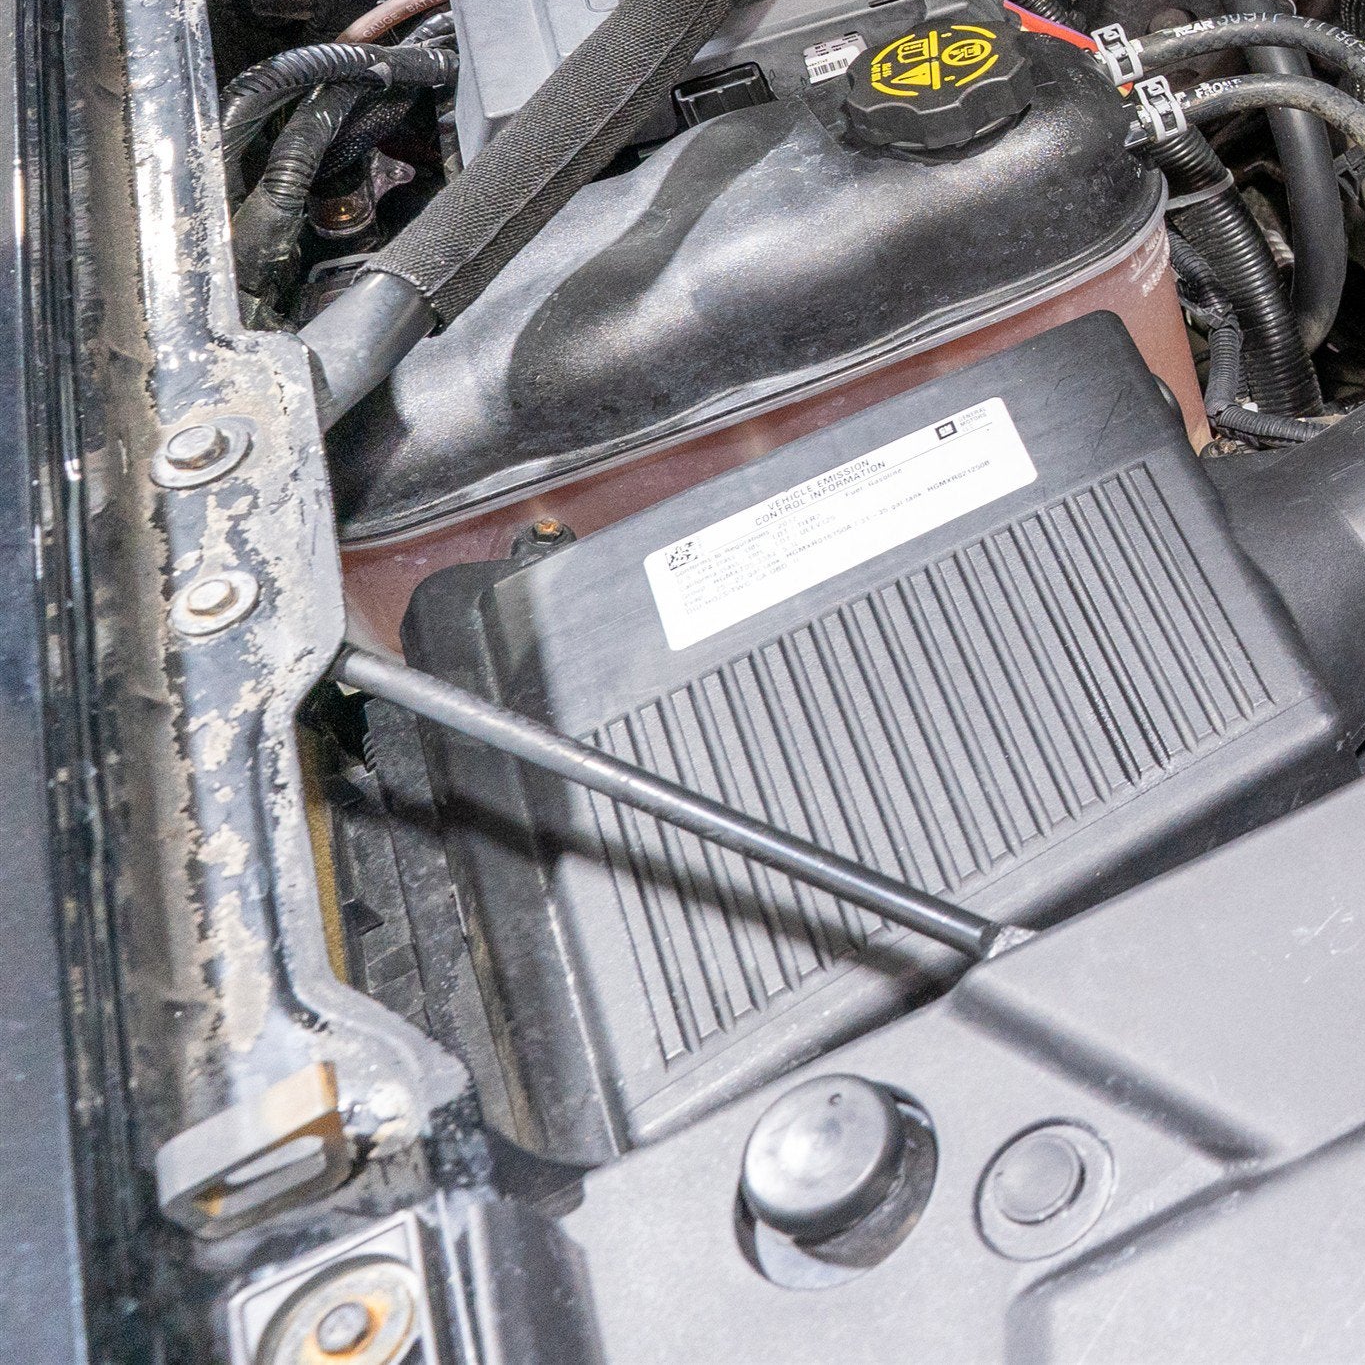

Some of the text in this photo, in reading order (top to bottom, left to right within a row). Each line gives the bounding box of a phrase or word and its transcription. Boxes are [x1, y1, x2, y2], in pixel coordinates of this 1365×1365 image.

[362, 13, 399, 37] GAUGE
[1173, 17, 1216, 38] REAR
[1194, 79, 1242, 99] FRONT
[957, 406, 986, 422] GENERAL
[959, 411, 987, 427] MOTORS
[767, 458, 869, 510] VEHICLE EMISSION
[867, 468, 902, 486] Gasoline
[754, 460, 885, 526] CONTROL INFORMATION
